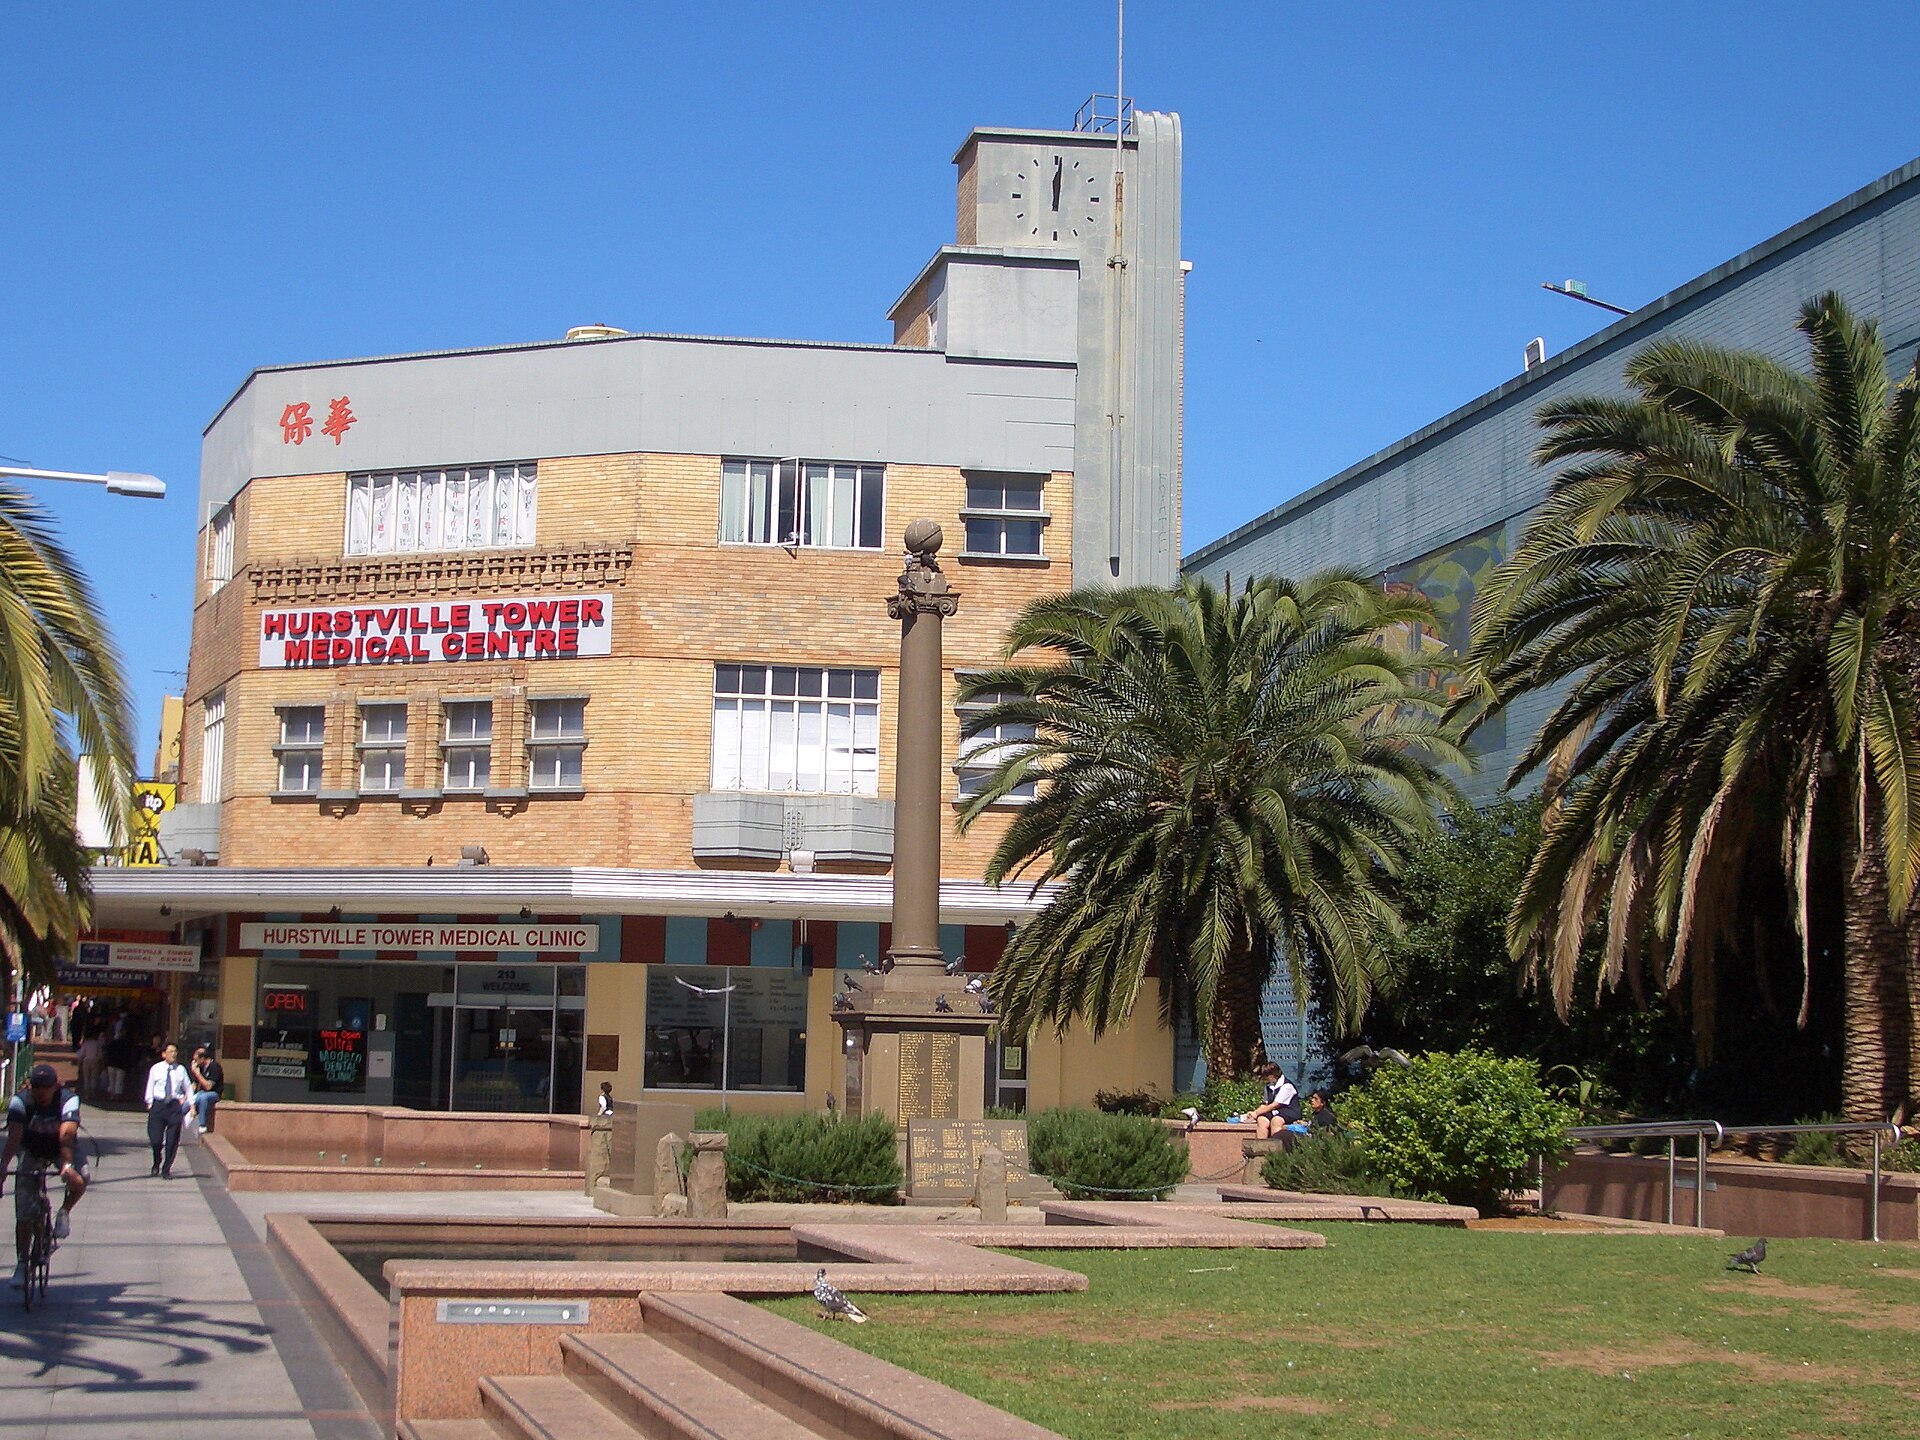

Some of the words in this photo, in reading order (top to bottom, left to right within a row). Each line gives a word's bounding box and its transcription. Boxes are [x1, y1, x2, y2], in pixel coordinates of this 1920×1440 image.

[280, 396, 357, 446] 保華
[264, 605, 471, 637] HURSTVILLE
[482, 599, 604, 627] TOWER
[284, 635, 430, 662] MEDICAL
[442, 628, 579, 658] CENTRE
[263, 929, 366, 944] HURSTVILLE
[372, 929, 434, 945] TOWER
[439, 930, 520, 946] MEDICAL
[526, 930, 587, 946] CLINIC
[57, 970, 92, 978] ENTAL
[497, 970, 516, 979] 213
[482, 981, 531, 992] WELCOME
[264, 992, 305, 1011] OPEN
[279, 1030, 288, 1042] 7
[341, 1030, 361, 1039] Open
[325, 1038, 354, 1052] Ultra
[319, 1050, 362, 1063] Modern
[324, 1061, 358, 1072] DENTAL
[327, 1071, 356, 1082] CLINIC
